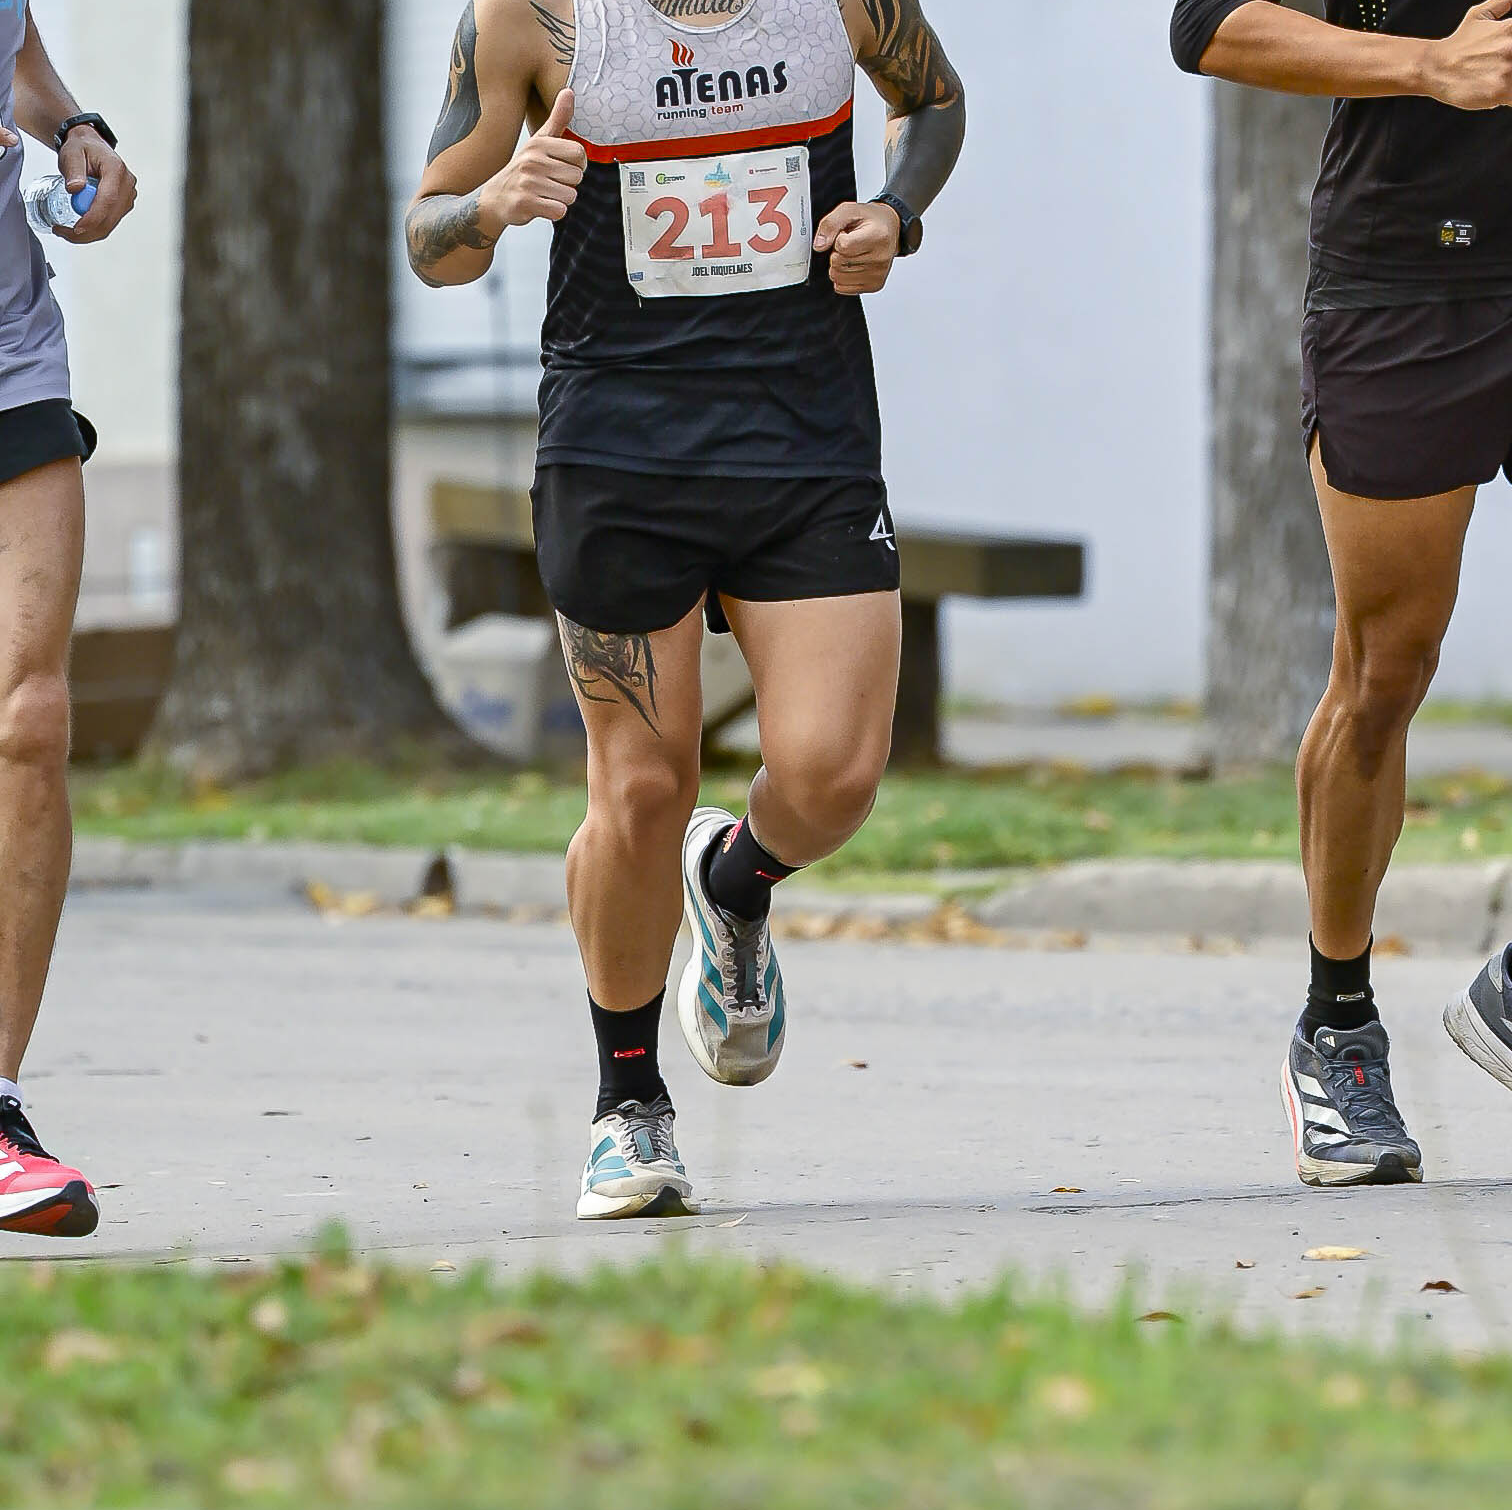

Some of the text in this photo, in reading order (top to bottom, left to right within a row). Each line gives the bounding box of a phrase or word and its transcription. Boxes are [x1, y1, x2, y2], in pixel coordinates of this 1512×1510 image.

[656, 60, 788, 108] ATENAS
[657, 103, 744, 121] running team
[644, 185, 793, 260] 213
[691, 263, 753, 276] JOEL RIQUELMES
